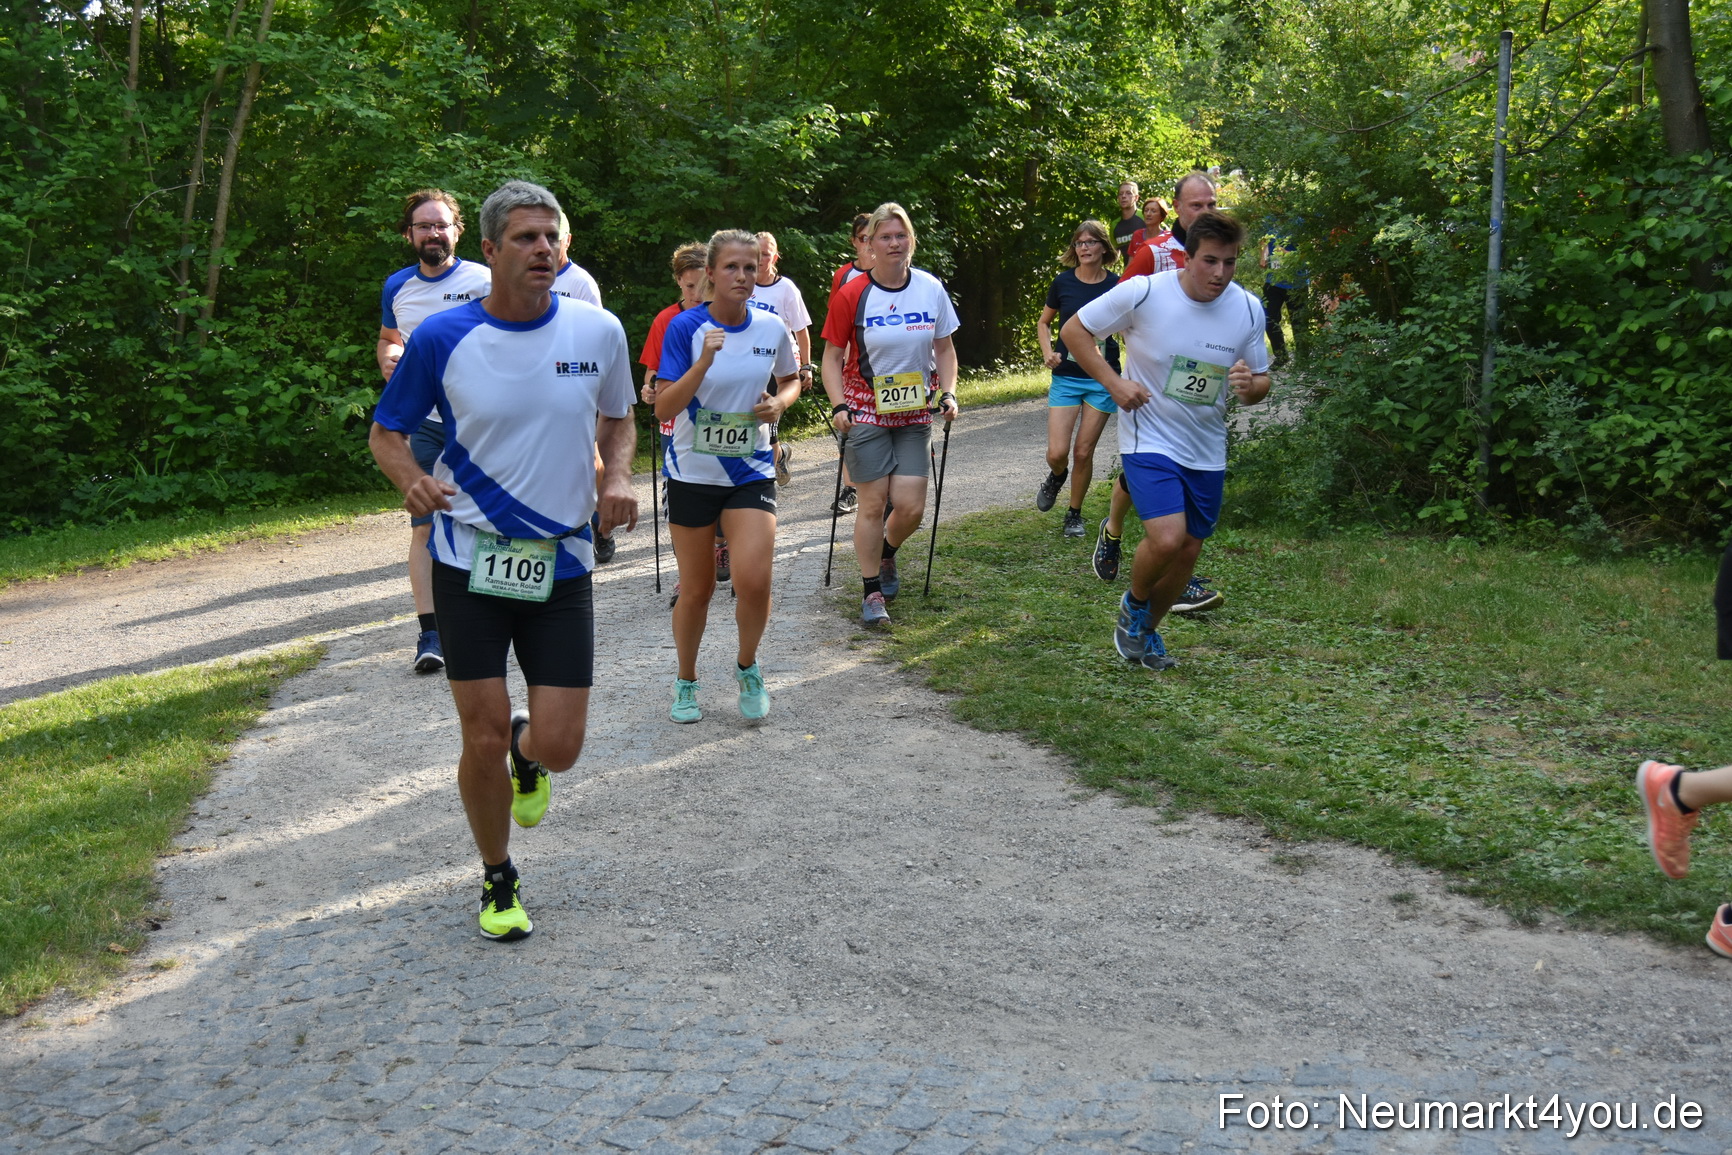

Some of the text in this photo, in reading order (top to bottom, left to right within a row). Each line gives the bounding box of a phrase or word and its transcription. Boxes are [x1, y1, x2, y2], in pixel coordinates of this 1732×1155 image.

[1205, 343, 1235, 354] auctores
[1184, 375, 1207, 393] 29
[881, 385, 917, 403] 2071
[703, 426, 749, 445] 1104
[485, 554, 546, 584] 1109
[485, 577, 542, 591] Ramsauer Roland
